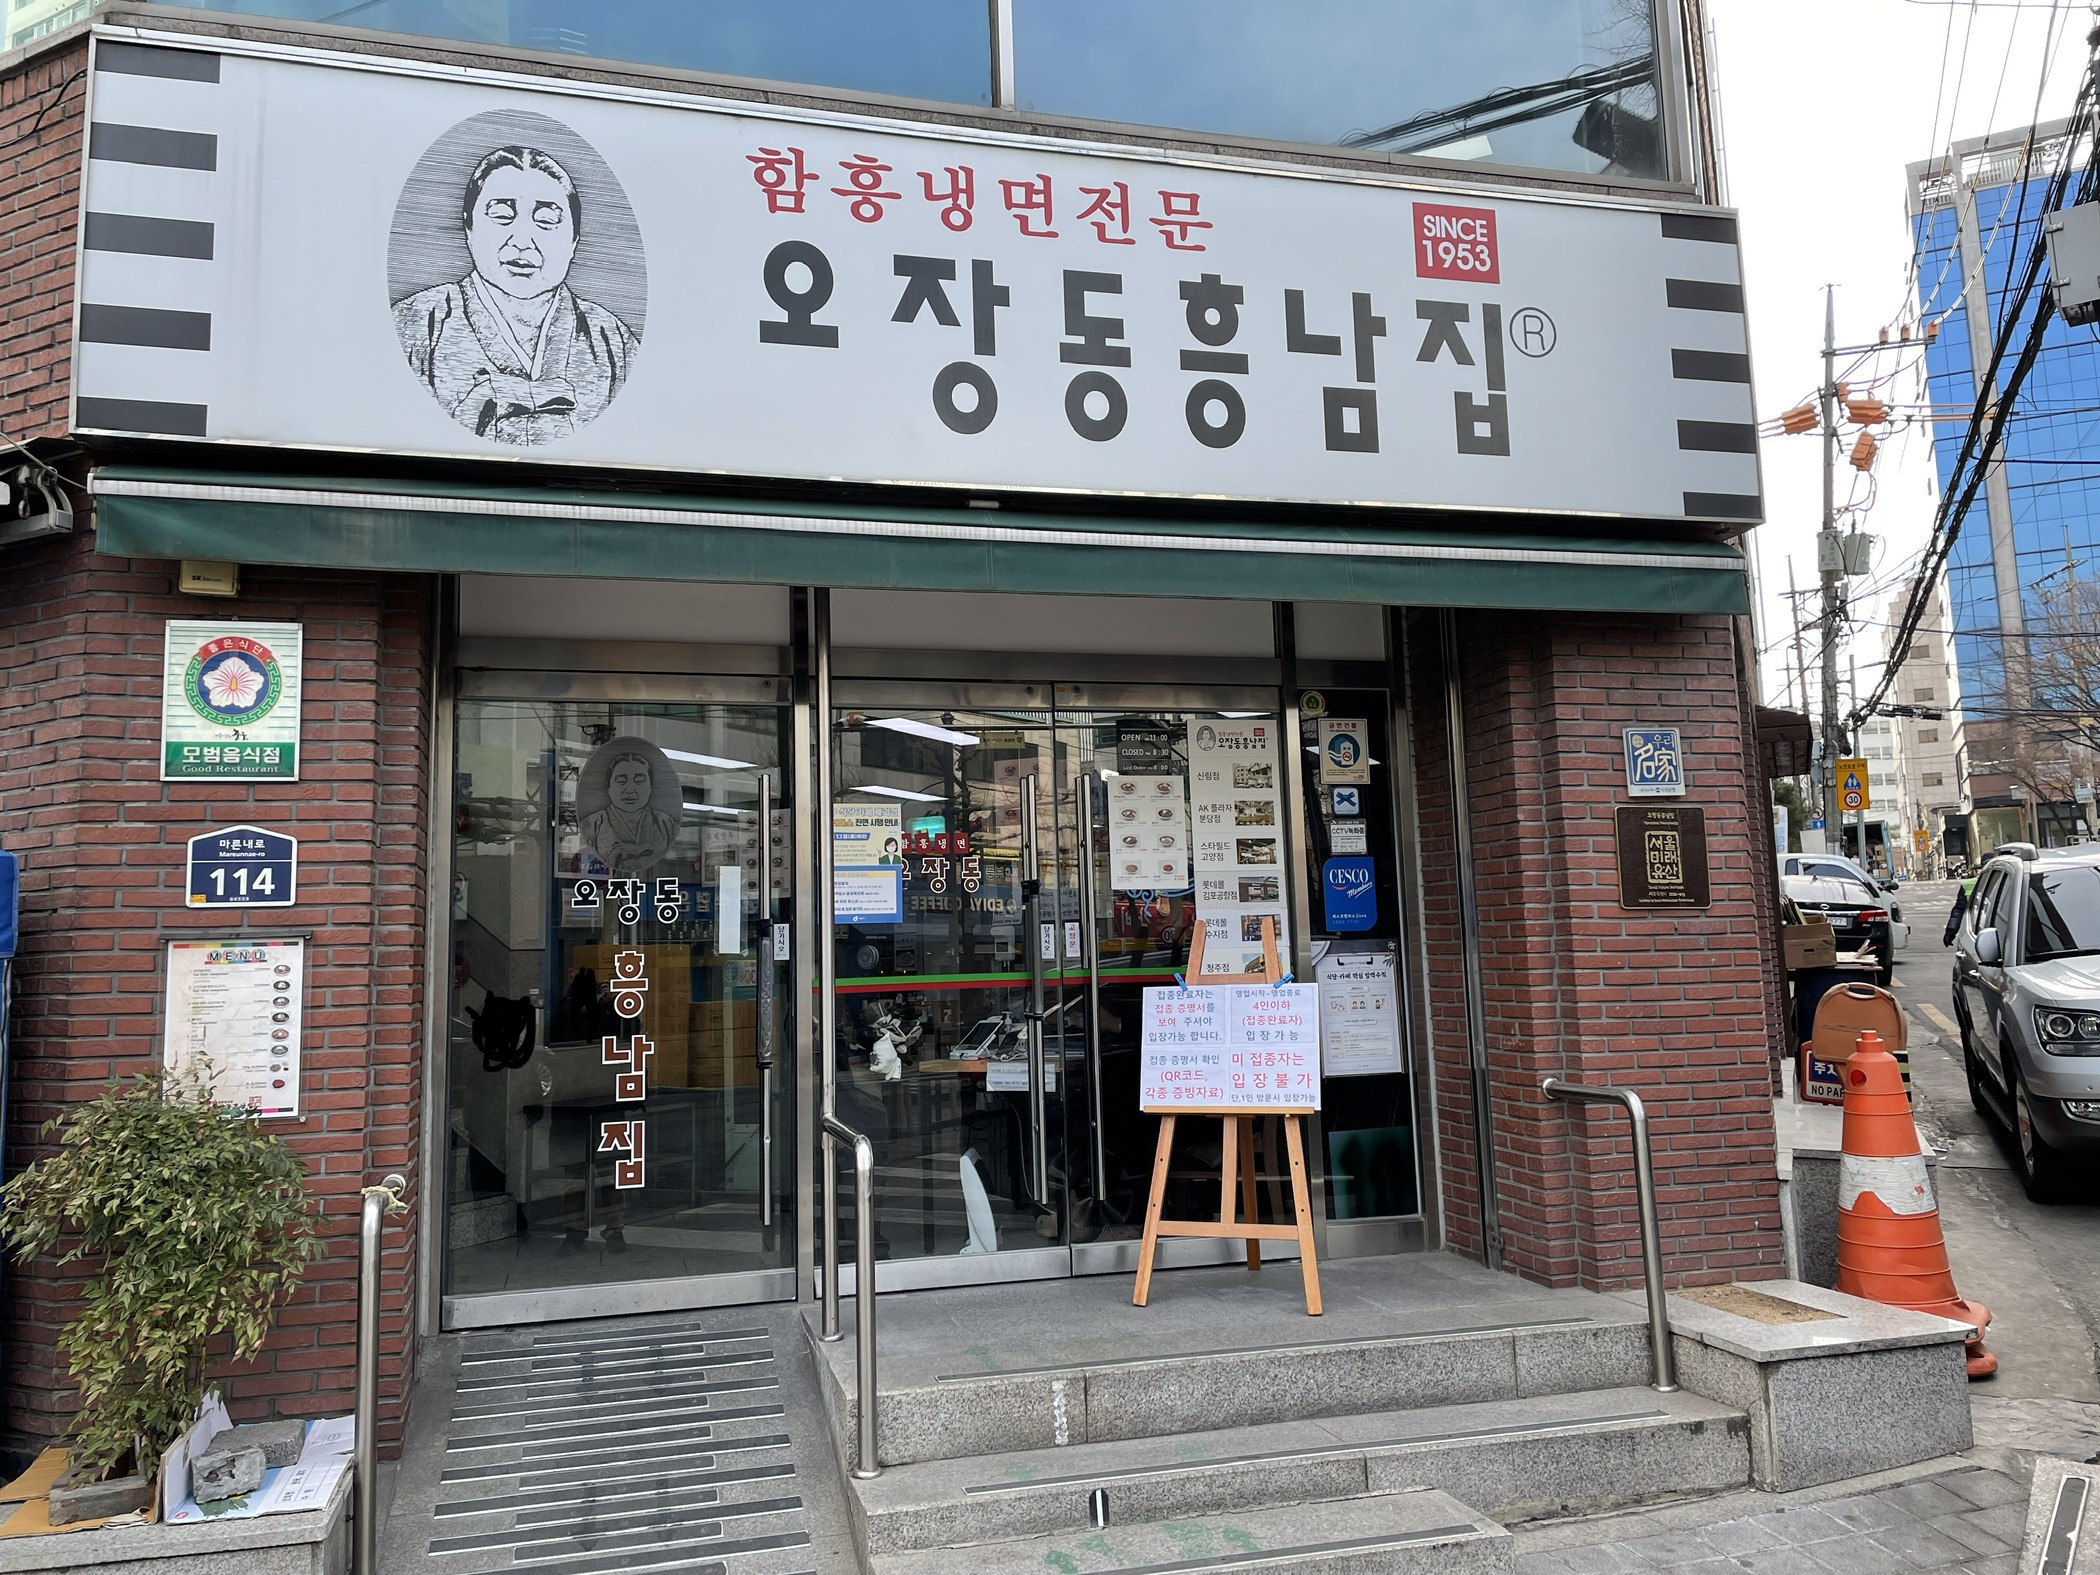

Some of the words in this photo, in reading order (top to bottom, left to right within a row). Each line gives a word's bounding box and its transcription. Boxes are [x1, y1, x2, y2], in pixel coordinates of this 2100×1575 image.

[746, 147, 1213, 252] 함흥냉면전문
[1422, 213, 1488, 242] SINCE
[1422, 239, 1492, 273] 1953
[758, 239, 1511, 457] 오장동흥남집
[1121, 733, 1141, 741] OPEN
[1651, 733, 1675, 749] 우리
[1217, 737, 1266, 750] 오장동흥남집
[182, 746, 281, 764] 모범음식점
[1121, 748, 1144, 756] CLOSED
[182, 764, 212, 773] Good
[216, 765, 279, 773] Restaurant
[1197, 771, 1220, 781] 신림점
[1848, 795, 1859, 804] 30
[1198, 804, 1209, 812] AK
[1210, 803, 1233, 813] 플라자
[855, 818, 869, 827] 전면
[884, 818, 899, 827] 안내
[1199, 814, 1221, 824] 분당점
[219, 839, 266, 850] 마른내로
[1200, 841, 1231, 851] 스타필드
[1649, 835, 1677, 851] 서울
[1200, 852, 1224, 862] 고양점
[1649, 850, 1678, 863] 미래
[1329, 868, 1369, 884] CESCO
[1650, 863, 1678, 880] 유산
[209, 867, 276, 896] 114
[1202, 880, 1226, 890] 롯데몰
[1202, 890, 1238, 901] 김포공항점
[1346, 881, 1373, 898] Members
[571, 877, 682, 925] 오장동
[209, 951, 262, 961] MENU
[1206, 963, 1230, 973] 청주점
[1364, 971, 1387, 979] 방역수칙
[1156, 989, 1214, 1001] 접종완료자는
[1155, 1003, 1174, 1014] 접종
[1177, 1002, 1216, 1013] 증명서를
[1253, 1000, 1291, 1011] 4인이하
[1157, 1017, 1176, 1027] 보여
[1242, 1015, 1303, 1027] (접종완료자)
[1148, 1031, 1188, 1042] 입장가능
[1190, 1030, 1222, 1042] 합니다.
[1149, 1055, 1168, 1066] 접종
[1170, 1054, 1198, 1066] 증명서
[1201, 1054, 1220, 1065] 확인
[1250, 1052, 1305, 1067] 접종자는
[1145, 1087, 1168, 1099] 각종
[1172, 1086, 1224, 1099] 증빙자료)
[1811, 1085, 1825, 1096] NO
[1256, 1093, 1281, 1102] 방문시
[1283, 1093, 1317, 1103] 입장가능
